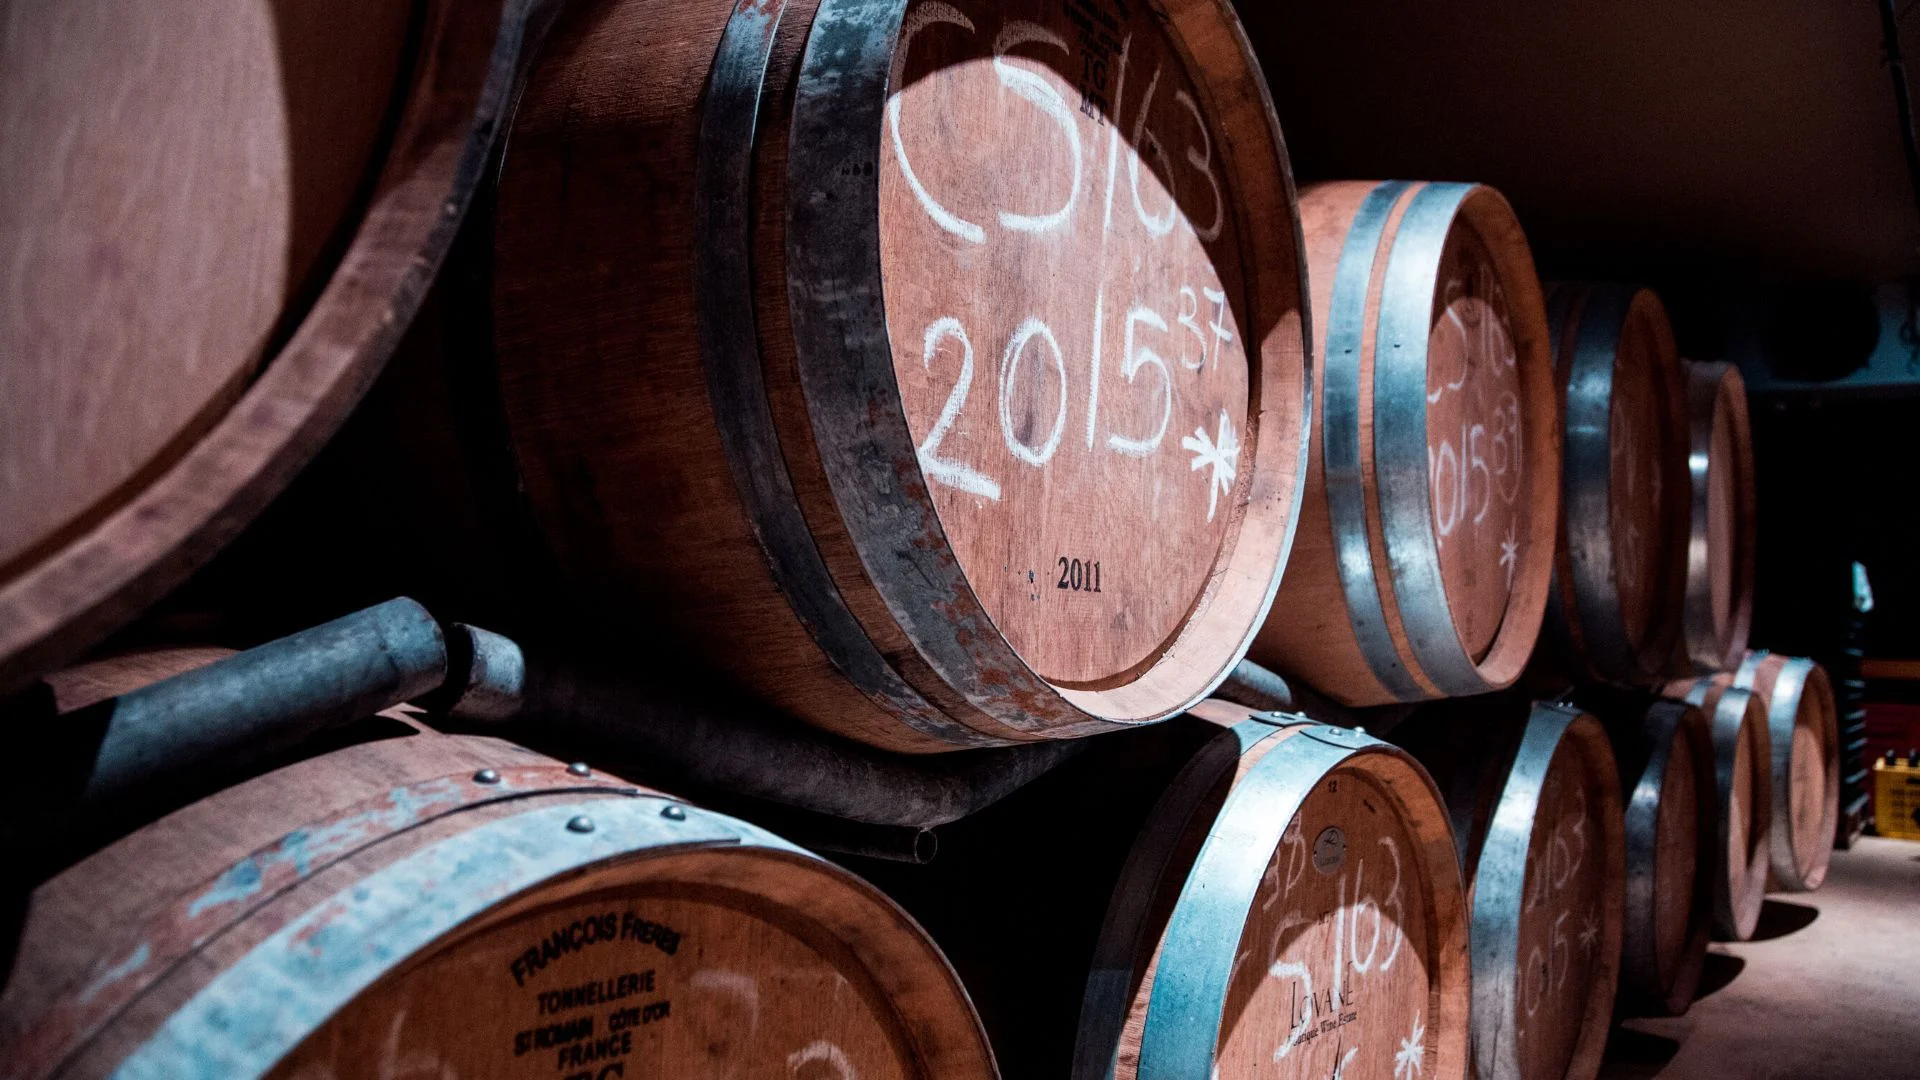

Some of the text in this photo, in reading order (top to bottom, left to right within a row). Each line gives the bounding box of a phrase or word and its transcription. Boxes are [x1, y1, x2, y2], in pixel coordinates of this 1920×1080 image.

[917, 282, 1234, 501] 2015 37
[1428, 415, 1491, 546] 015
[1057, 556, 1102, 593] 2011
[537, 969, 656, 1016] TONNELLERIE
[557, 1030, 632, 1070] FRANCE
